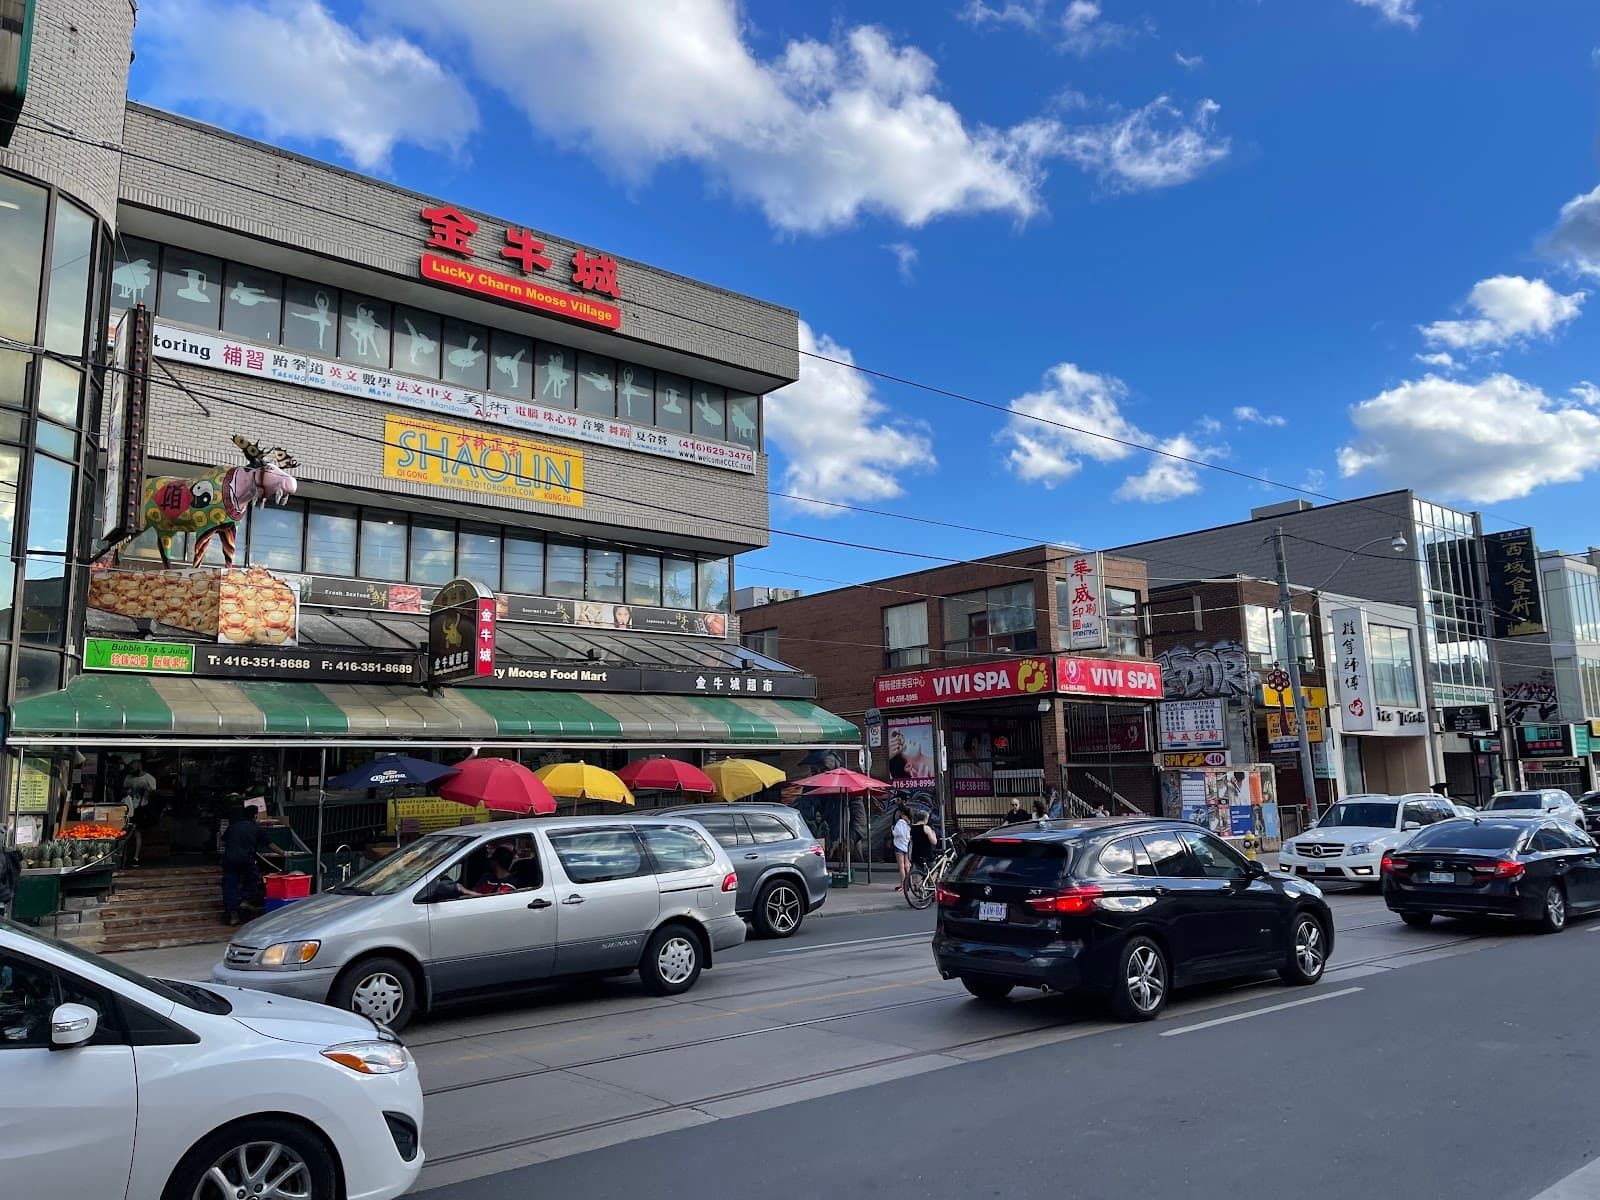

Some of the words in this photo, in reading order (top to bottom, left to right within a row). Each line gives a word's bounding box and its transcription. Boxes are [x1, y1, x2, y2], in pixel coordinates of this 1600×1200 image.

[421, 205, 621, 298] 金牛城
[432, 260, 475, 283] Lucky
[478, 273, 522, 296] Charm
[525, 287, 567, 308] Moose
[570, 300, 612, 321] Village
[153, 334, 211, 360] toring
[223, 344, 265, 371] 補習
[331, 381, 362, 393] English
[397, 394, 425, 406] French
[431, 400, 470, 414] Mandarin
[506, 415, 543, 428] Computer
[456, 429, 520, 457] 少林正宗
[678, 439, 752, 462] (416)629-3476
[397, 430, 572, 494] SHAOLIN
[407, 470, 428, 481] GONG
[544, 492, 562, 503] KUNG
[562, 495, 571, 503] FU
[1071, 559, 1096, 604] 華威
[1501, 540, 1536, 617] 西域食府
[1072, 602, 1097, 618] 印刷
[479, 608, 492, 662] 金牛城
[111, 643, 141, 653] Bubble
[143, 645, 158, 654] Tea
[168, 646, 190, 656] Juice
[207, 655, 221, 665] T:
[224, 655, 310, 670] 416-351-8688
[321, 660, 333, 670] F:
[335, 661, 412, 674] 416-351-8689
[508, 667, 547, 679] Moose
[550, 669, 578, 680] Food
[581, 670, 607, 682] Mart
[932, 674, 970, 696] VIVI
[973, 670, 1011, 692] SPA
[1090, 667, 1123, 688] VIVI
[1127, 670, 1157, 690] SPA
[1165, 754, 1182, 767] SPA
[370, 772, 407, 783] Corona
